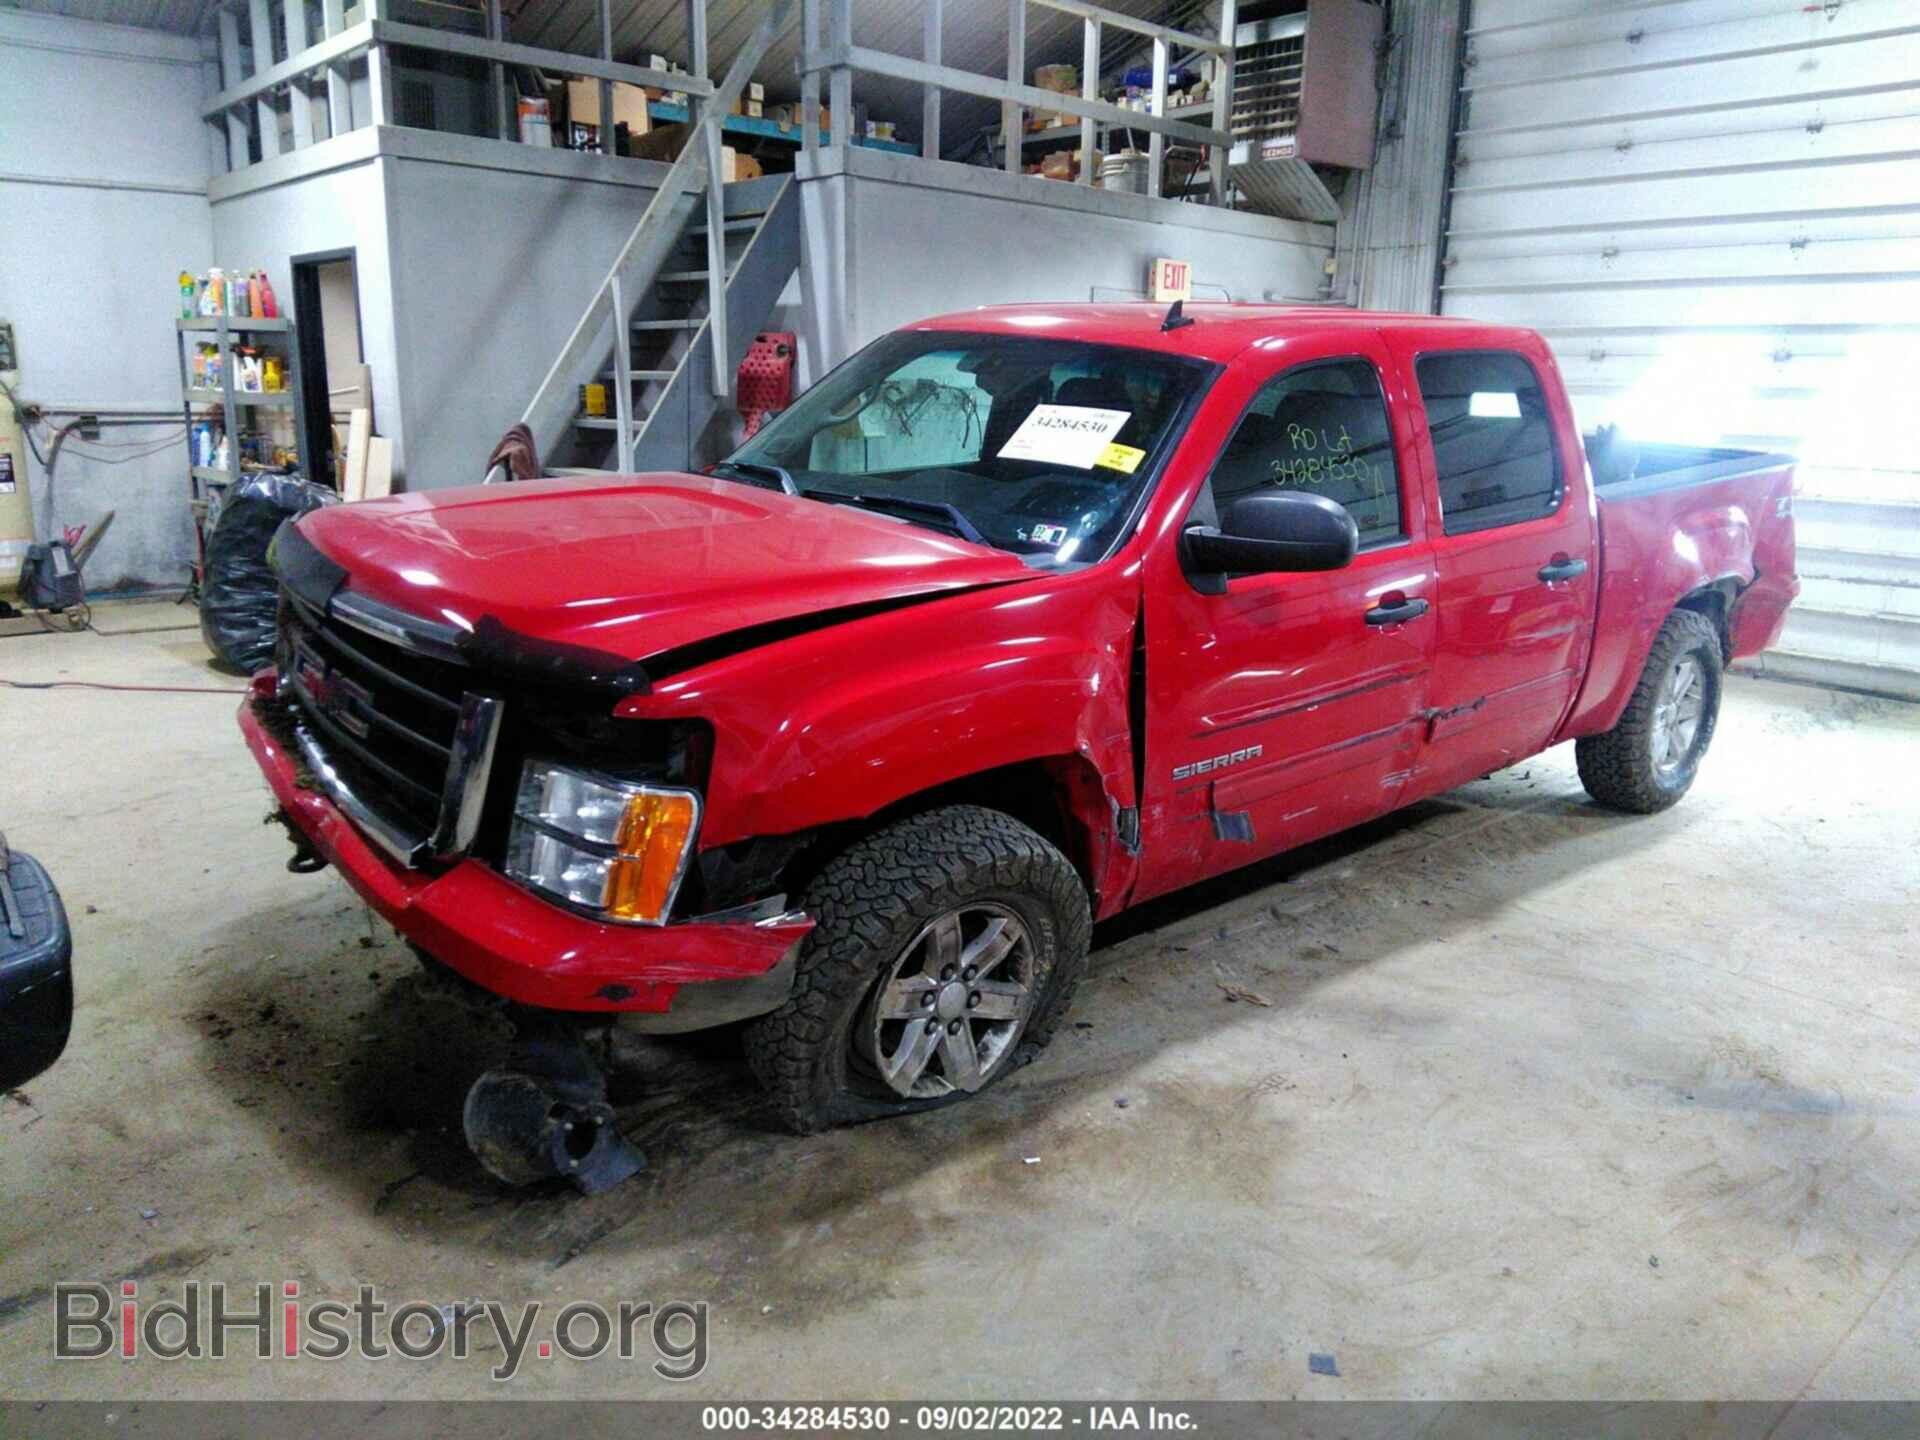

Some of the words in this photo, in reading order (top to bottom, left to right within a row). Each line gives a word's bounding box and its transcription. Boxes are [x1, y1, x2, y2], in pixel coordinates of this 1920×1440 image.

[1164, 263, 1187, 291] EXIT
[1031, 415, 1109, 434] 34284530
[1172, 744, 1263, 781] SIERRA
